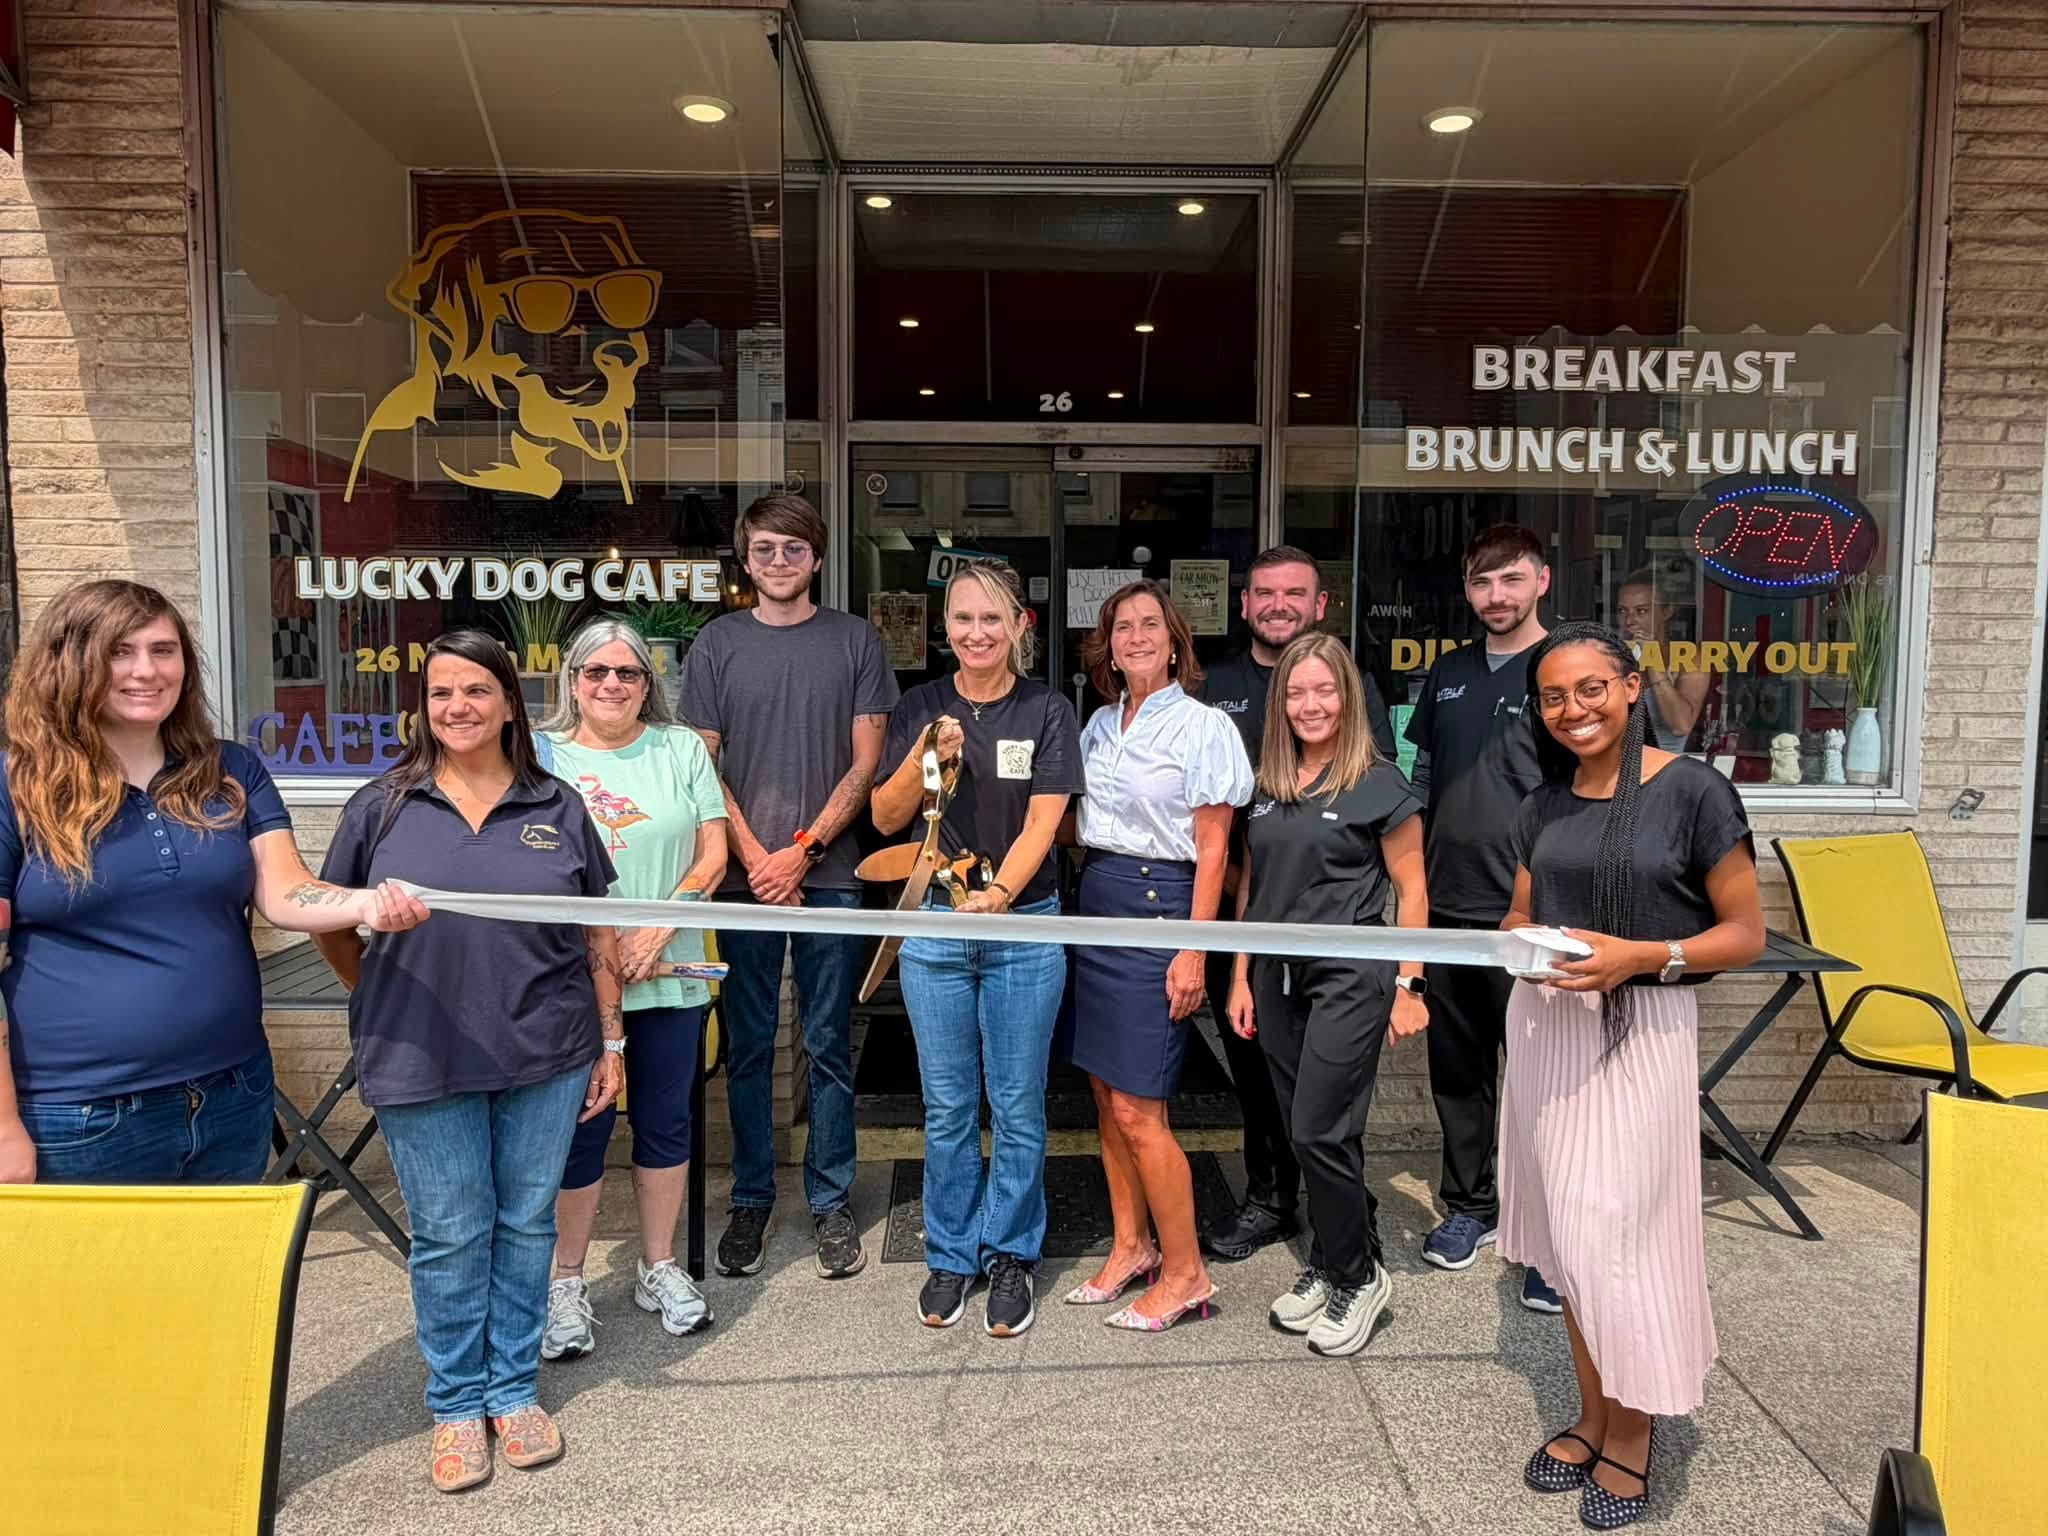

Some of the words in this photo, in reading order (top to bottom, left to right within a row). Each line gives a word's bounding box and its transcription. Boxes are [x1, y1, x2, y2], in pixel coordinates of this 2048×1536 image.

[1472, 344, 1797, 393] BREAKFAST
[1039, 391, 1073, 412] 26
[1405, 426, 1625, 473] BRUNCH
[1635, 428, 1678, 477] &
[1685, 428, 1858, 475] LUNCH
[1695, 502, 1863, 570] OPEN
[295, 556, 463, 600] LUCKY
[471, 557, 585, 601] DOG
[591, 559, 721, 601] CAFE
[356, 644, 401, 673] 26
[1764, 641, 1857, 675] OUT
[248, 711, 404, 767] CAFE
